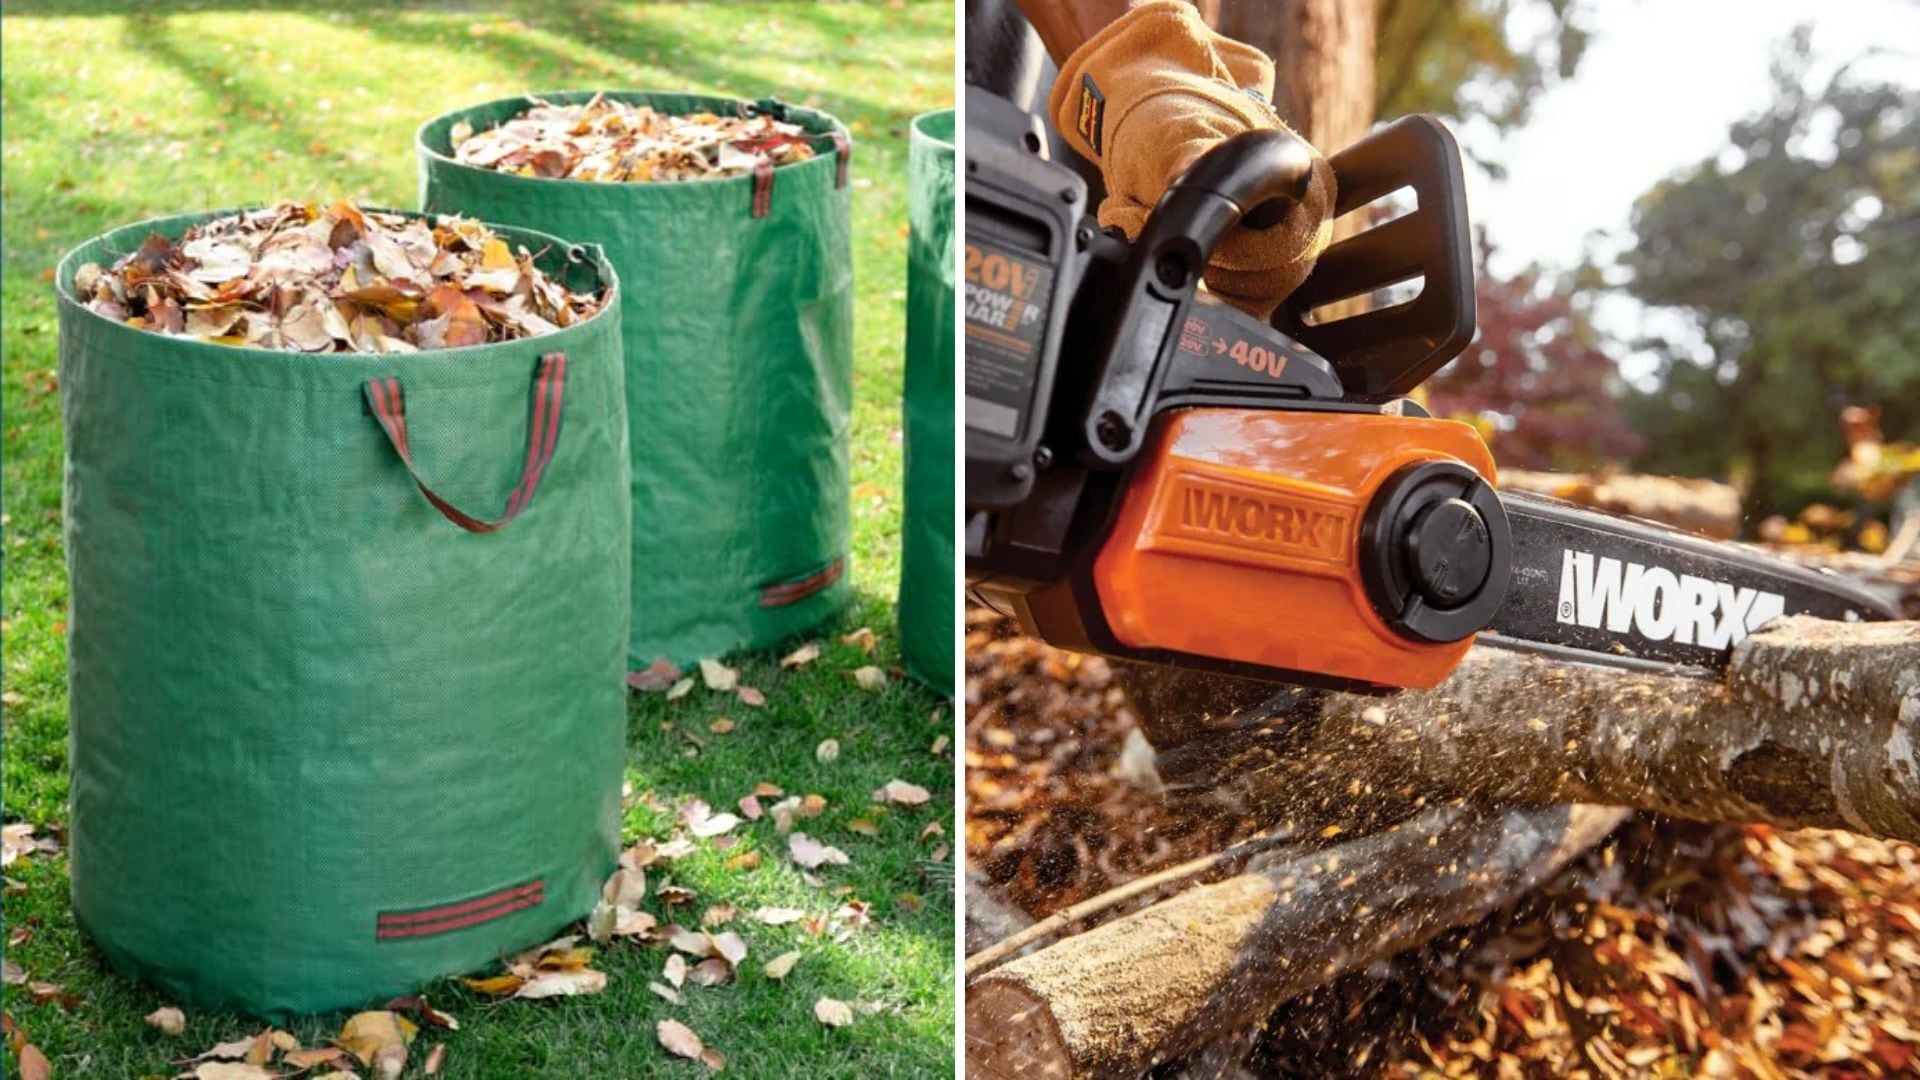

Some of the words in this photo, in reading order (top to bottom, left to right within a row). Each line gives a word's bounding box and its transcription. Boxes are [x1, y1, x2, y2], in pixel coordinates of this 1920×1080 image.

[1229, 340, 1288, 378] 40V
[1192, 488, 1331, 548] WORX
[1573, 550, 1759, 651] WORX
